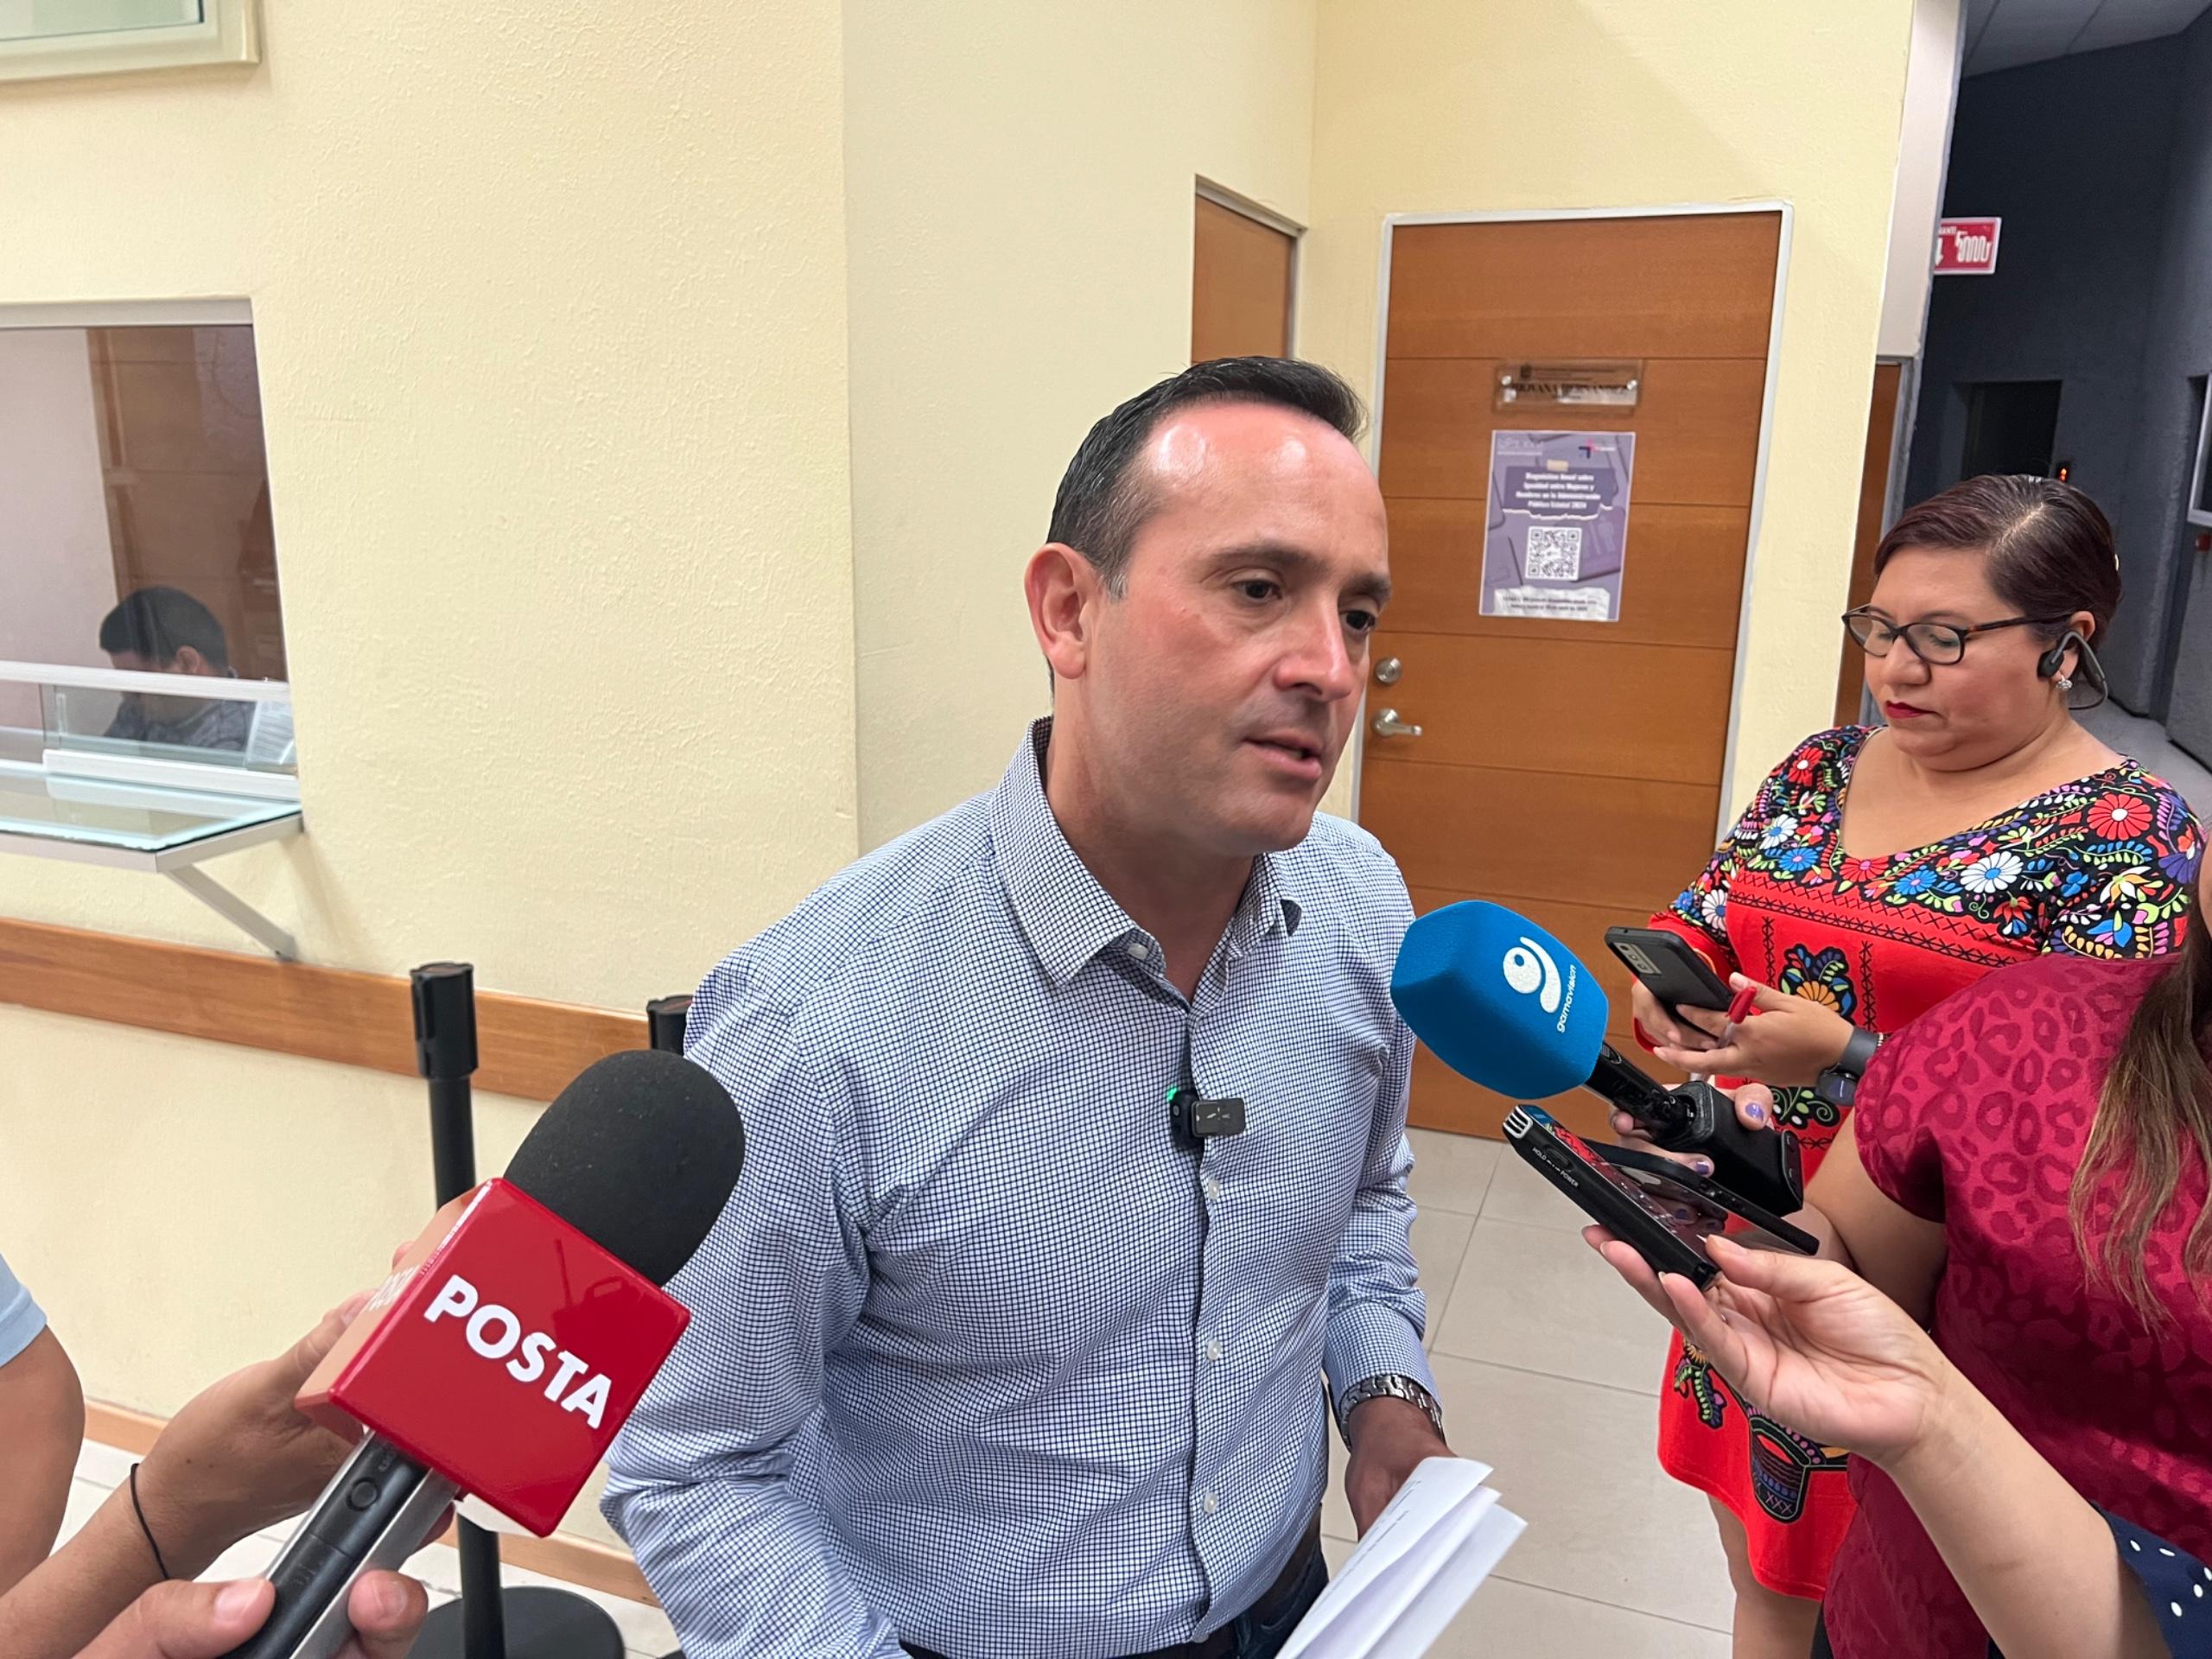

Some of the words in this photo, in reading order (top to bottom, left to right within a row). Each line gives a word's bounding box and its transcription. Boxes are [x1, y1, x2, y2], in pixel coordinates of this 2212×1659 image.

[1556, 964, 1576, 1033] gamavision
[1533, 1147, 1547, 1160] HOLD
[1560, 1170, 1579, 1187] POWER
[423, 1274, 613, 1430] POSTA
